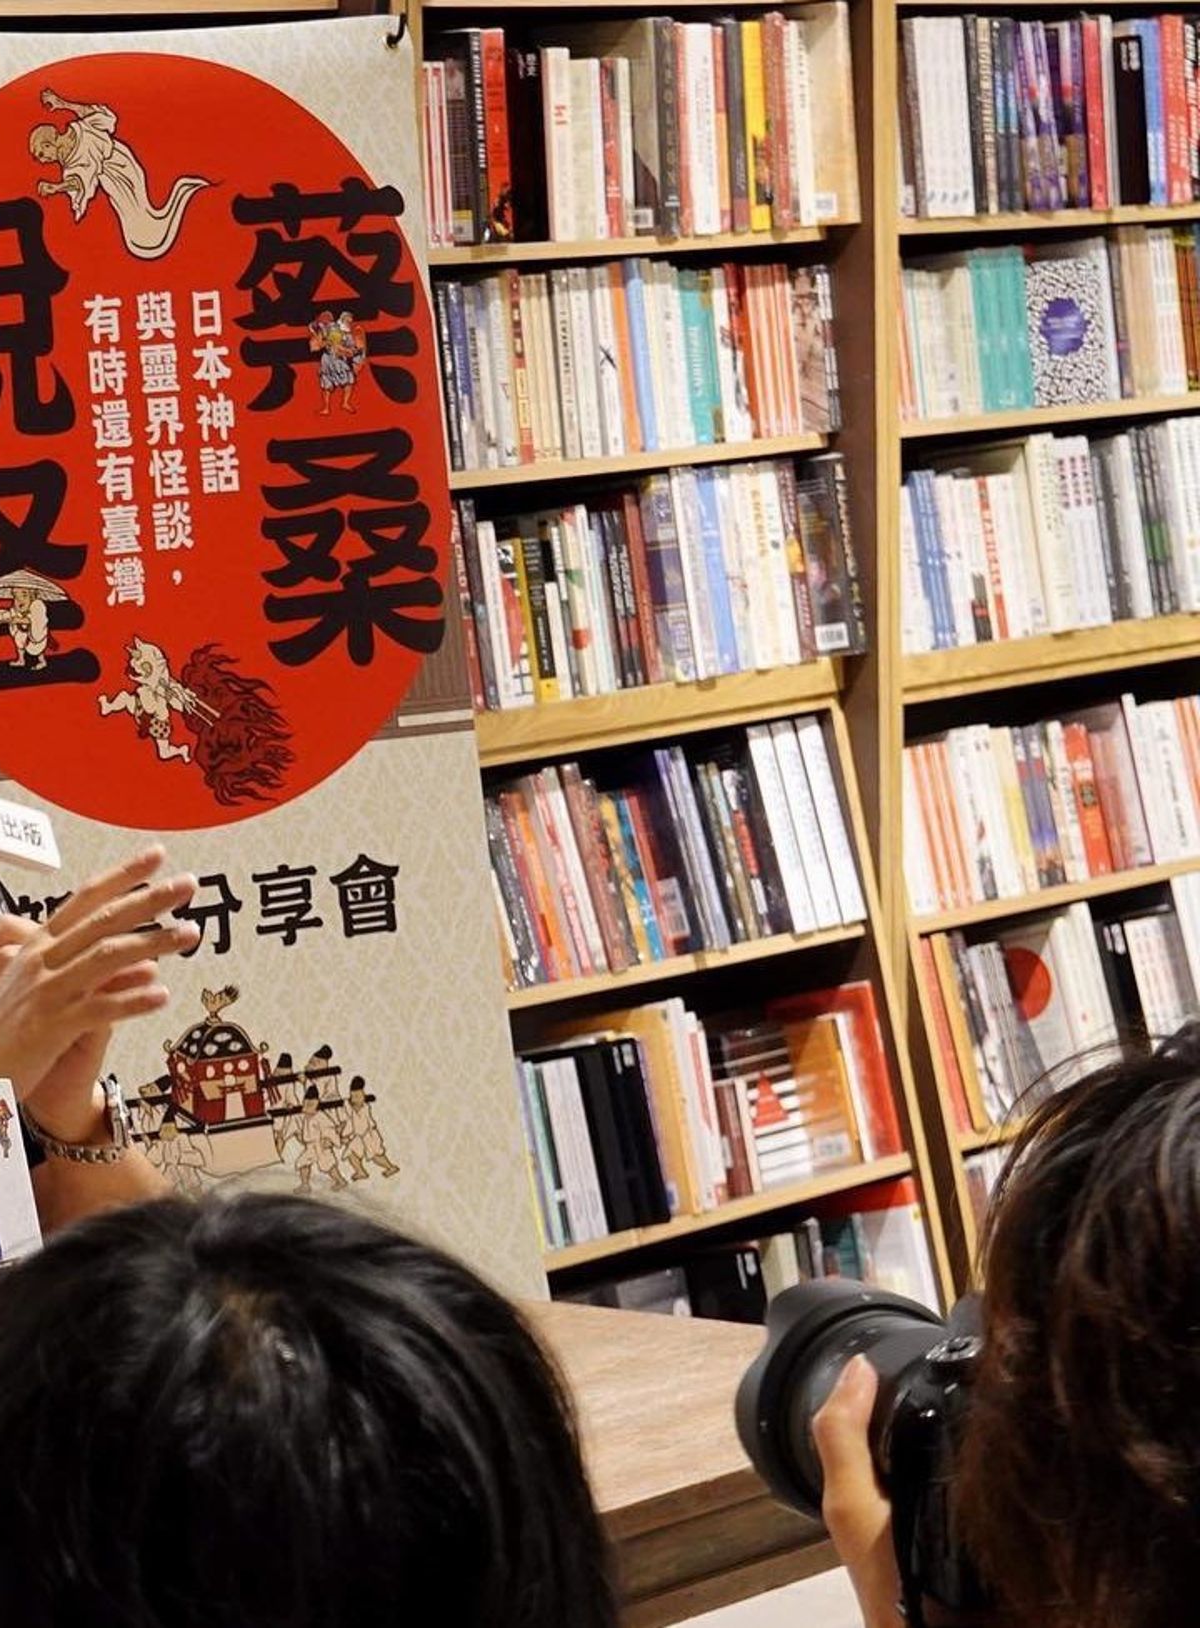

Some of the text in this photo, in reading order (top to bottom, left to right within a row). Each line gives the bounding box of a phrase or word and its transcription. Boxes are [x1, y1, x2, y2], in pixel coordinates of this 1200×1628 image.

[83, 293, 147, 607] 有時還有臺灣
[191, 290, 240, 495] 日本神話
[232, 176, 446, 668] 蔡桑
